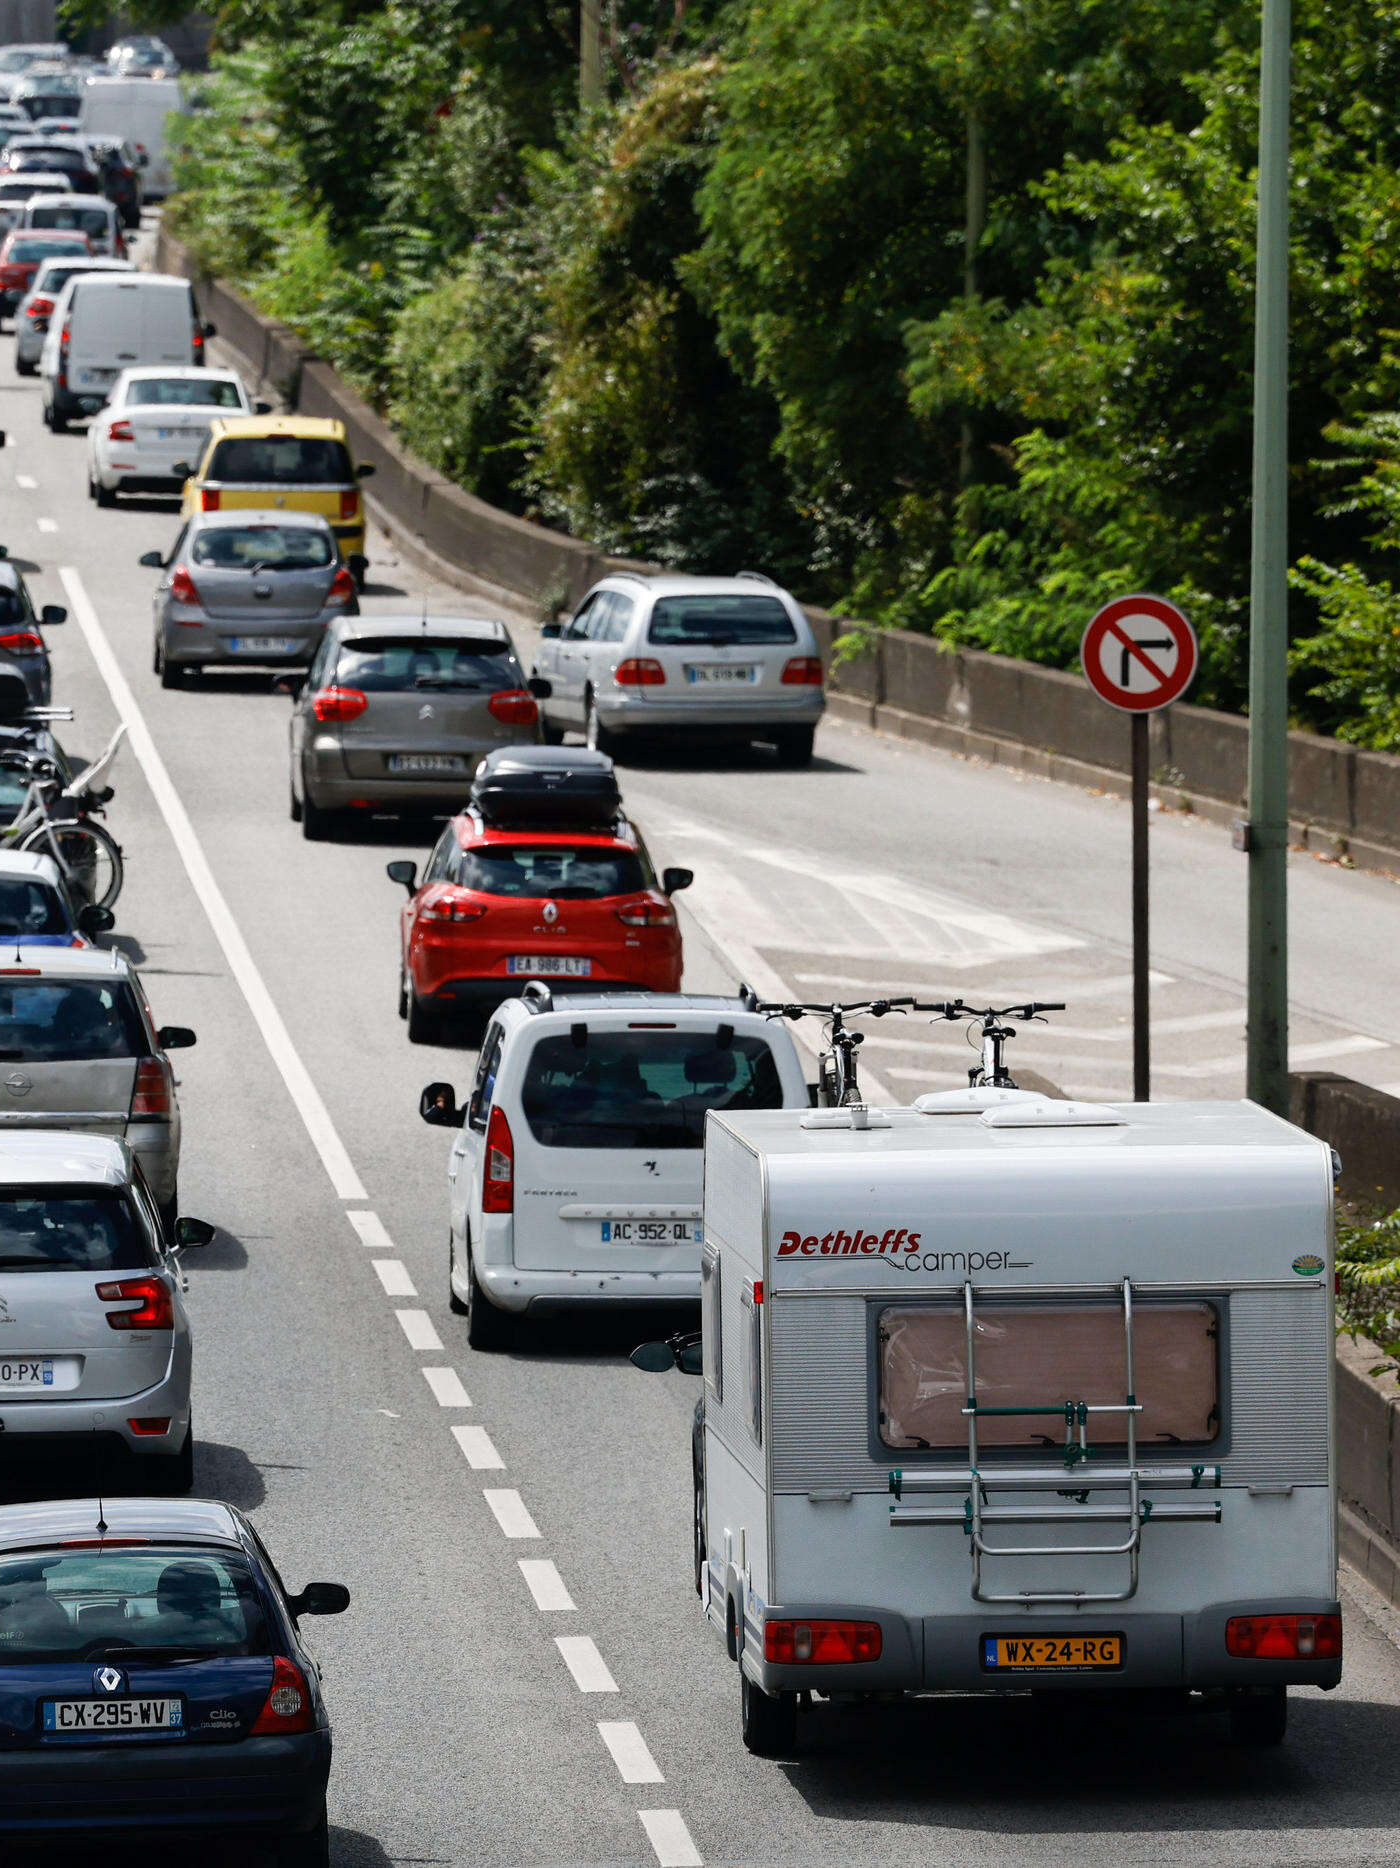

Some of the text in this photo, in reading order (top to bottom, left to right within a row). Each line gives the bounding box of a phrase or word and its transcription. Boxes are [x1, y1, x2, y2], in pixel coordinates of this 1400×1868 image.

[613, 1224, 692, 1240] AC-952-QL
[777, 1229, 922, 1256] Dethleffs
[905, 1249, 1012, 1275] camper
[1005, 1641, 1115, 1662] WX-24-RG
[58, 1702, 165, 1727] CX-295-WV
